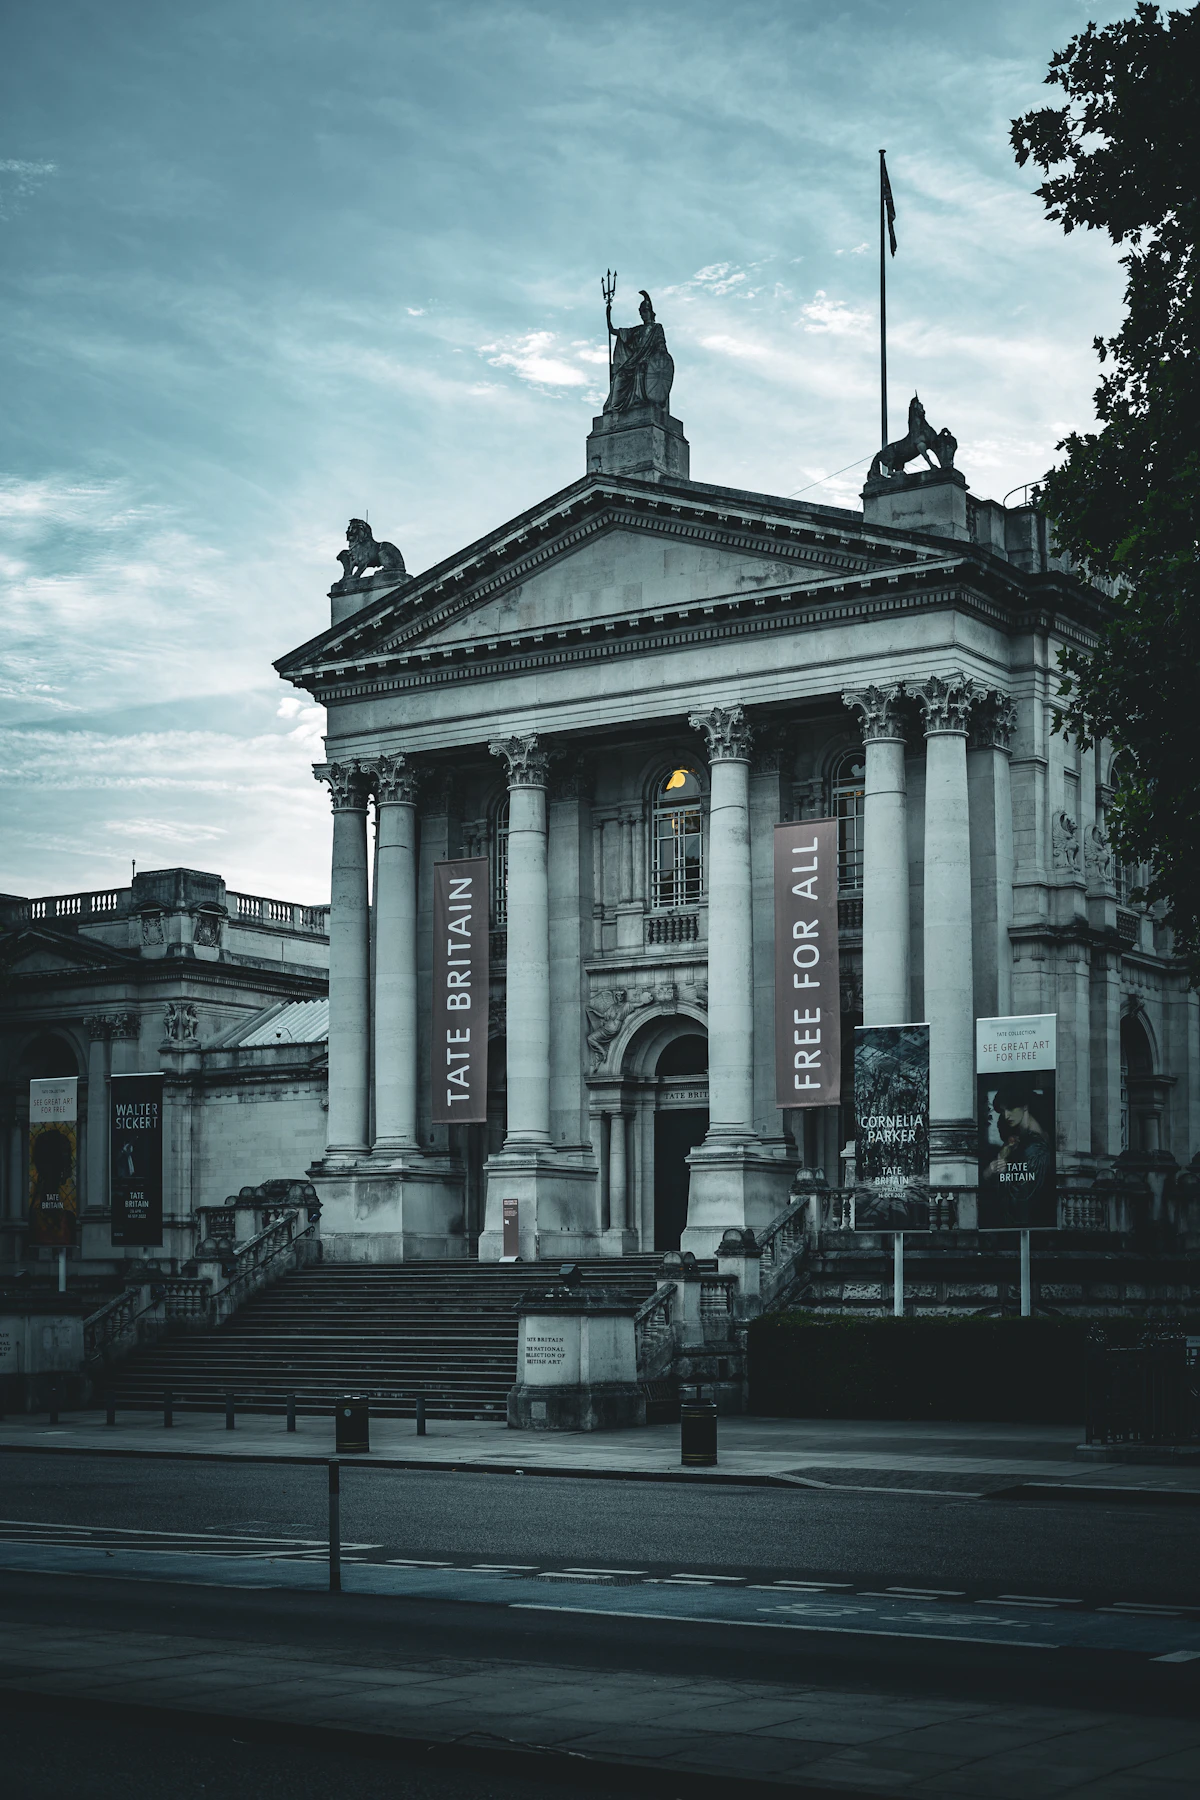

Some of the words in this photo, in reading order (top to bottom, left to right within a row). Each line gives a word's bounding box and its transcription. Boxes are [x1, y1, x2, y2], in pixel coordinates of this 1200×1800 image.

[792, 836, 818, 900] ALL
[447, 877, 473, 1010] BRITAIN
[793, 919, 820, 989] FOR
[794, 1007, 821, 1090] FREE
[983, 1043, 998, 1053] SEE
[1001, 1041, 1029, 1051] GREAT
[1032, 1040, 1050, 1049] ART
[996, 1052, 1013, 1061] FOR
[1016, 1051, 1037, 1060] FREE
[447, 1027, 470, 1107] TATE
[41, 1106, 51, 1114] FOR
[116, 1103, 158, 1116] WALTER
[116, 1117, 158, 1129] SICKERT
[861, 1115, 923, 1128] CORNELIA
[868, 1130, 916, 1143] PARKER
[882, 1166, 902, 1175] TATE
[1007, 1162, 1028, 1172] TATE
[874, 1176, 909, 1185] BRITAIN
[1000, 1172, 1035, 1182] BRITAIN
[46, 1193, 59, 1201] TATE
[130, 1191, 144, 1200] TATE
[125, 1200, 149, 1208] BRITAIN
